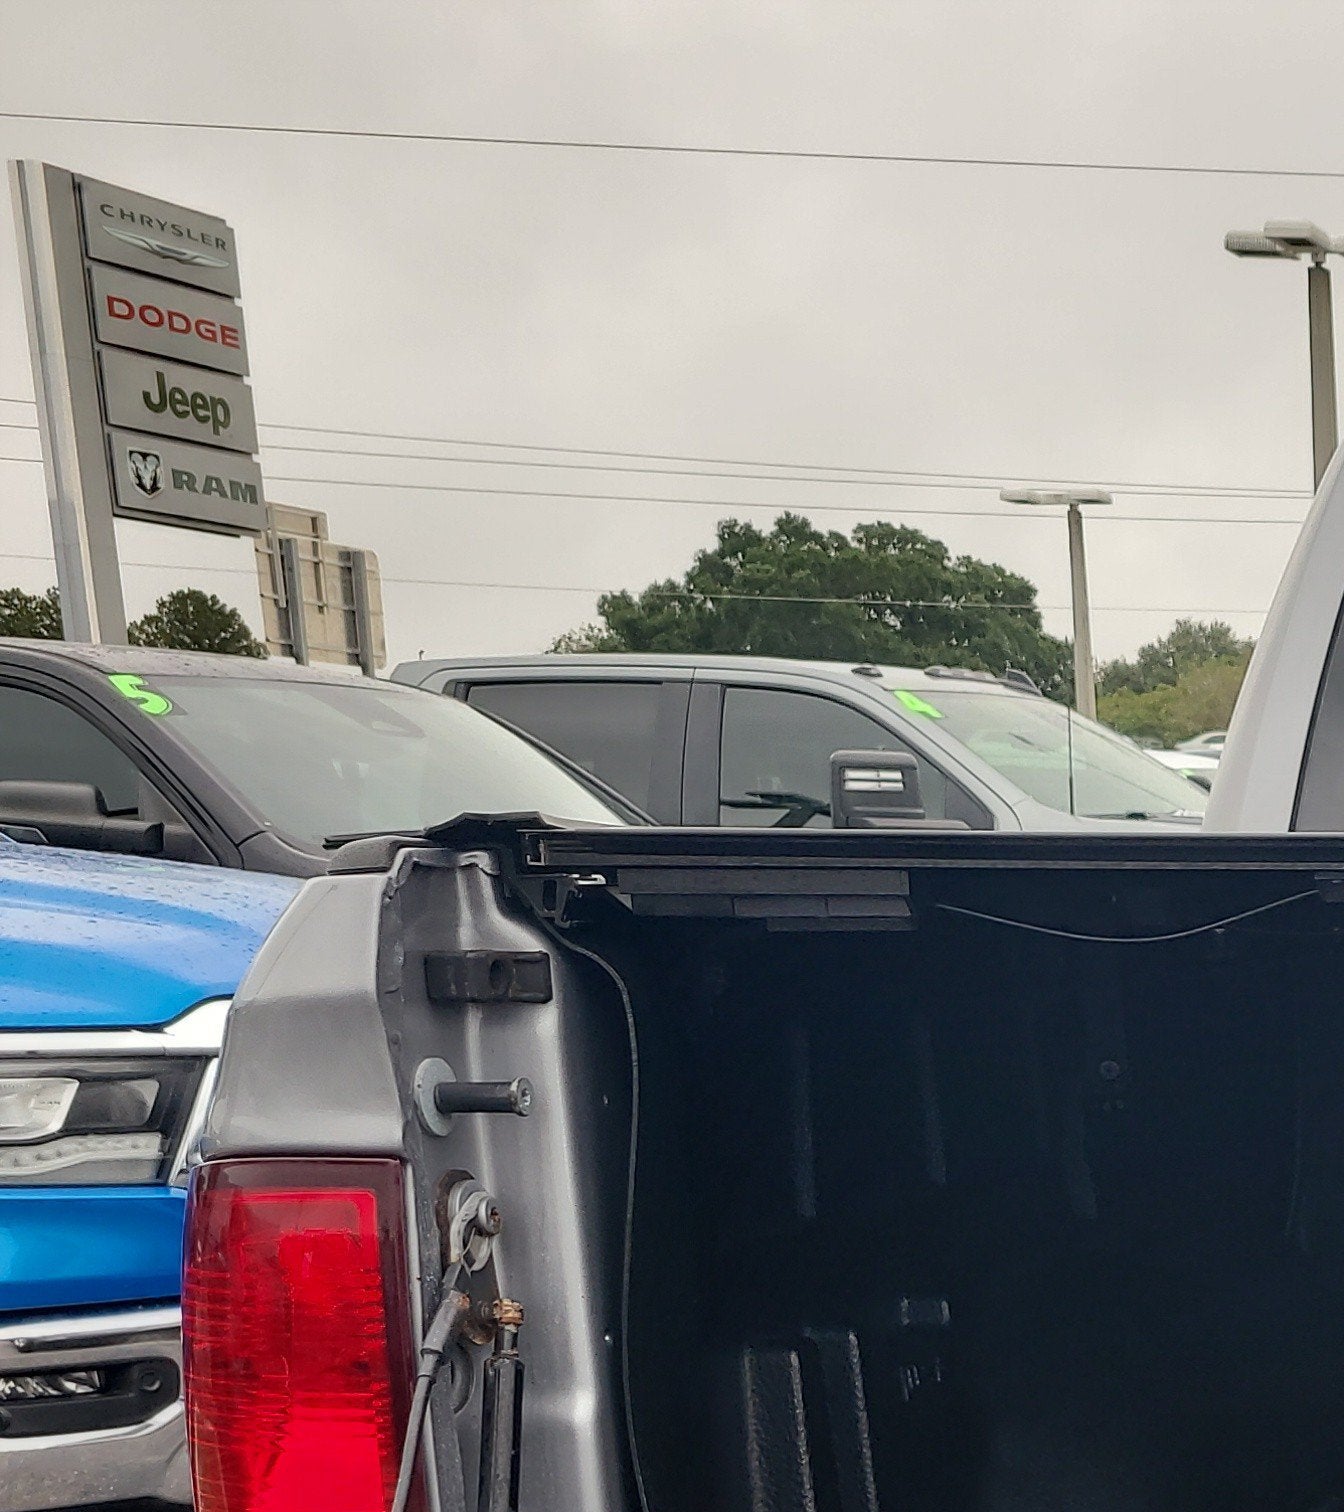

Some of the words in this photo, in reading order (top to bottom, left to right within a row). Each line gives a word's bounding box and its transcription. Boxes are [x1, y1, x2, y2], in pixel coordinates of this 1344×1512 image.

[100, 203, 227, 251] CHRYSLER
[106, 294, 241, 350] DODGE
[142, 370, 231, 436] Jeep
[172, 468, 259, 506] RAM
[107, 673, 173, 716] 5
